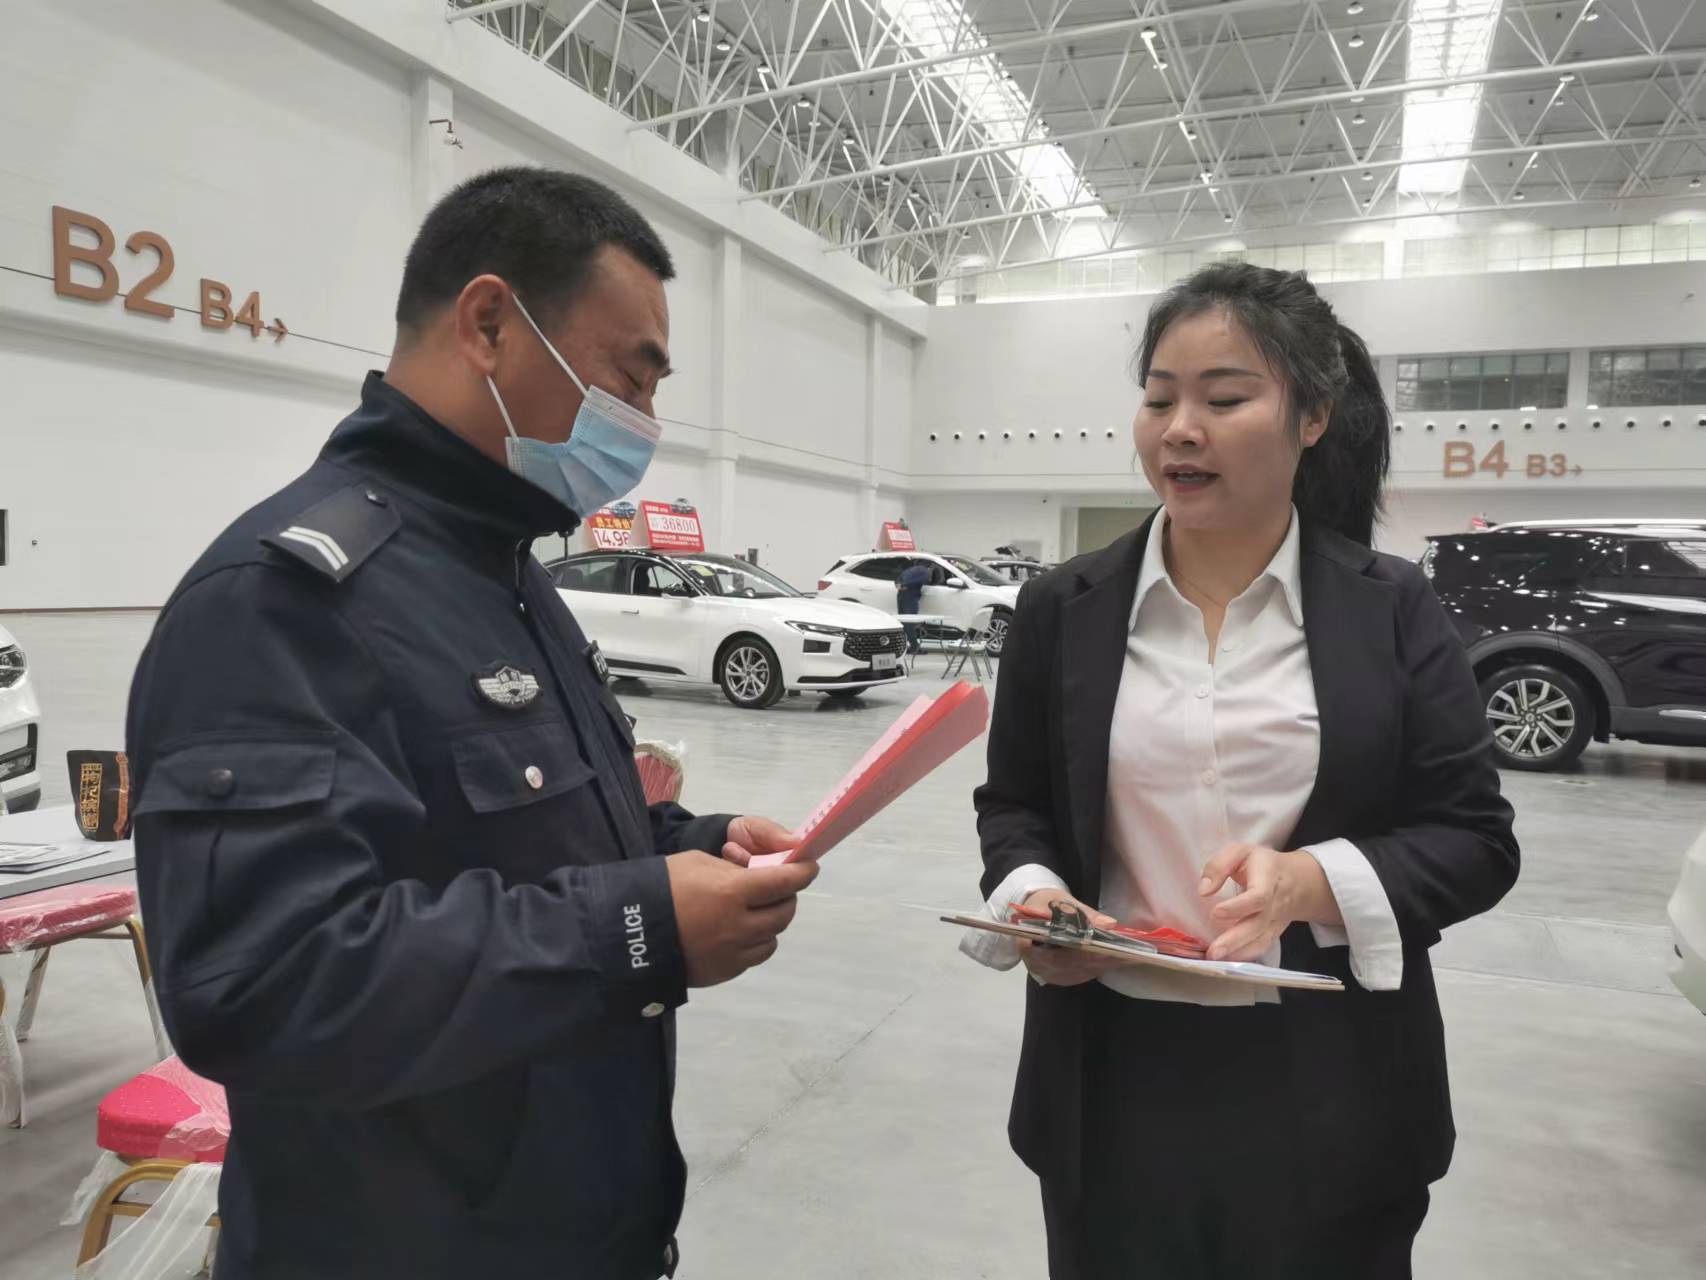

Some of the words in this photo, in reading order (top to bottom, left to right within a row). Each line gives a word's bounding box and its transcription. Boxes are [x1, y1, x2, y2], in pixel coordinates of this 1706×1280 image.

[53, 205, 175, 318] B2
[200, 278, 265, 337] B4
[1443, 440, 1509, 478] B4
[1526, 453, 1567, 478] B3
[623, 904, 650, 968] POLICE
